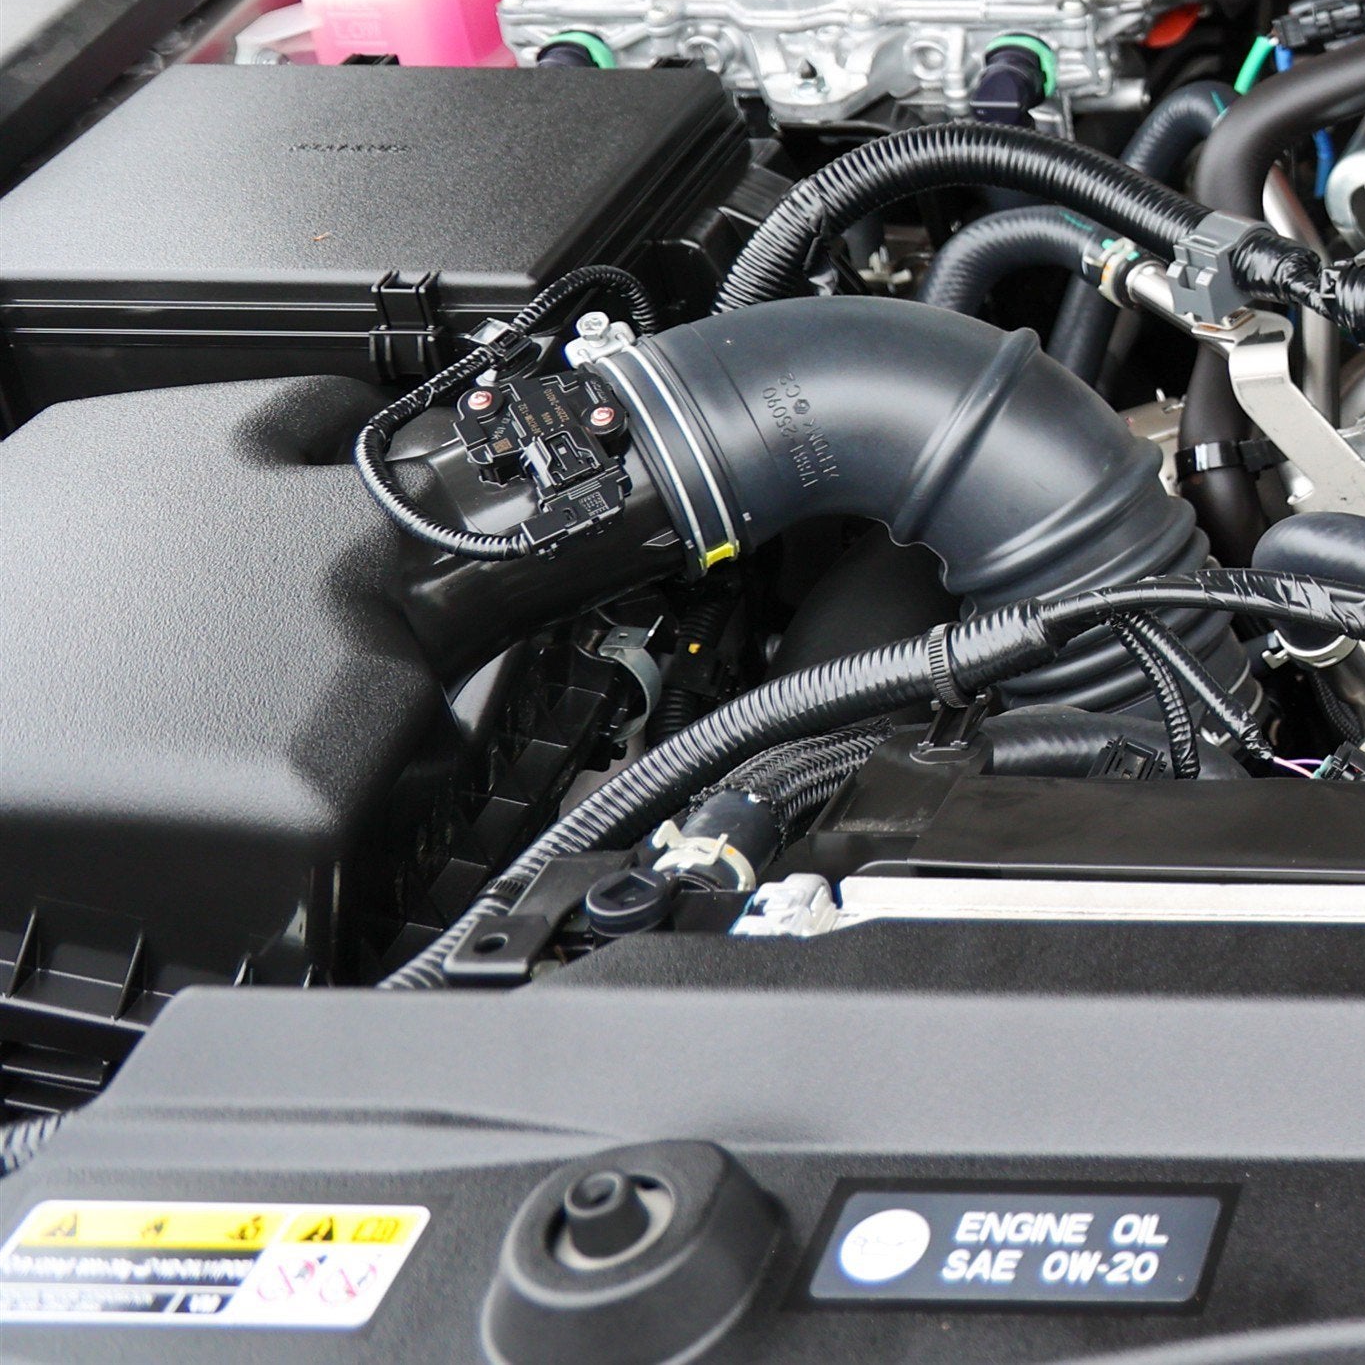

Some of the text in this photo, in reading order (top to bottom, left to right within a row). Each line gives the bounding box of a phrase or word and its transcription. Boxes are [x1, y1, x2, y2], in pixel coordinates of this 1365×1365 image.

[955, 1211, 1171, 1246] ENGINE OIL
[940, 1251, 1160, 1284] SAE 0W-20
